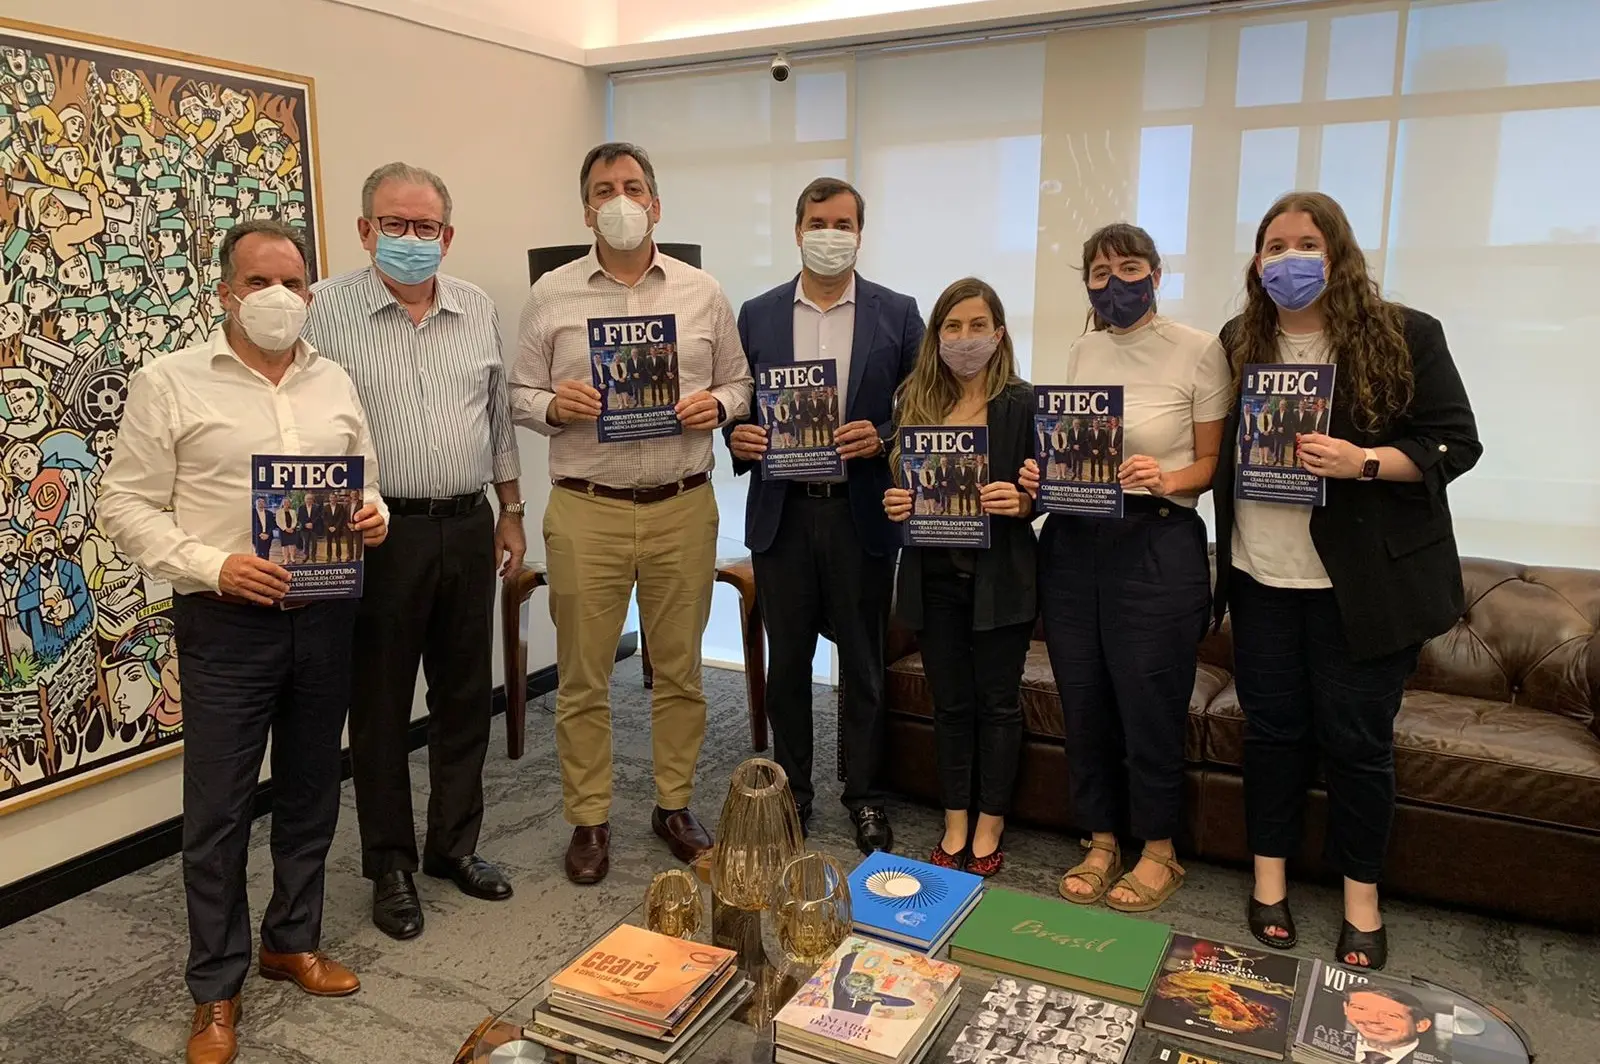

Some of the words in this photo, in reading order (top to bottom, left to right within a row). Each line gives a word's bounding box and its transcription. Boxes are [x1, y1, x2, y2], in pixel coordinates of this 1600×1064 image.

[603, 321, 664, 346] FIEC
[769, 366, 824, 389] FIEC
[1256, 371, 1318, 395] FIEC
[1048, 392, 1108, 414] FIEC
[914, 432, 974, 453] FIEC
[271, 463, 348, 488] FIEC
[326, 568, 357, 576] FUTURO:
[1011, 919, 1118, 953] Brasil
[580, 951, 660, 982] ceará
[1314, 1030, 1355, 1051] LIRA
